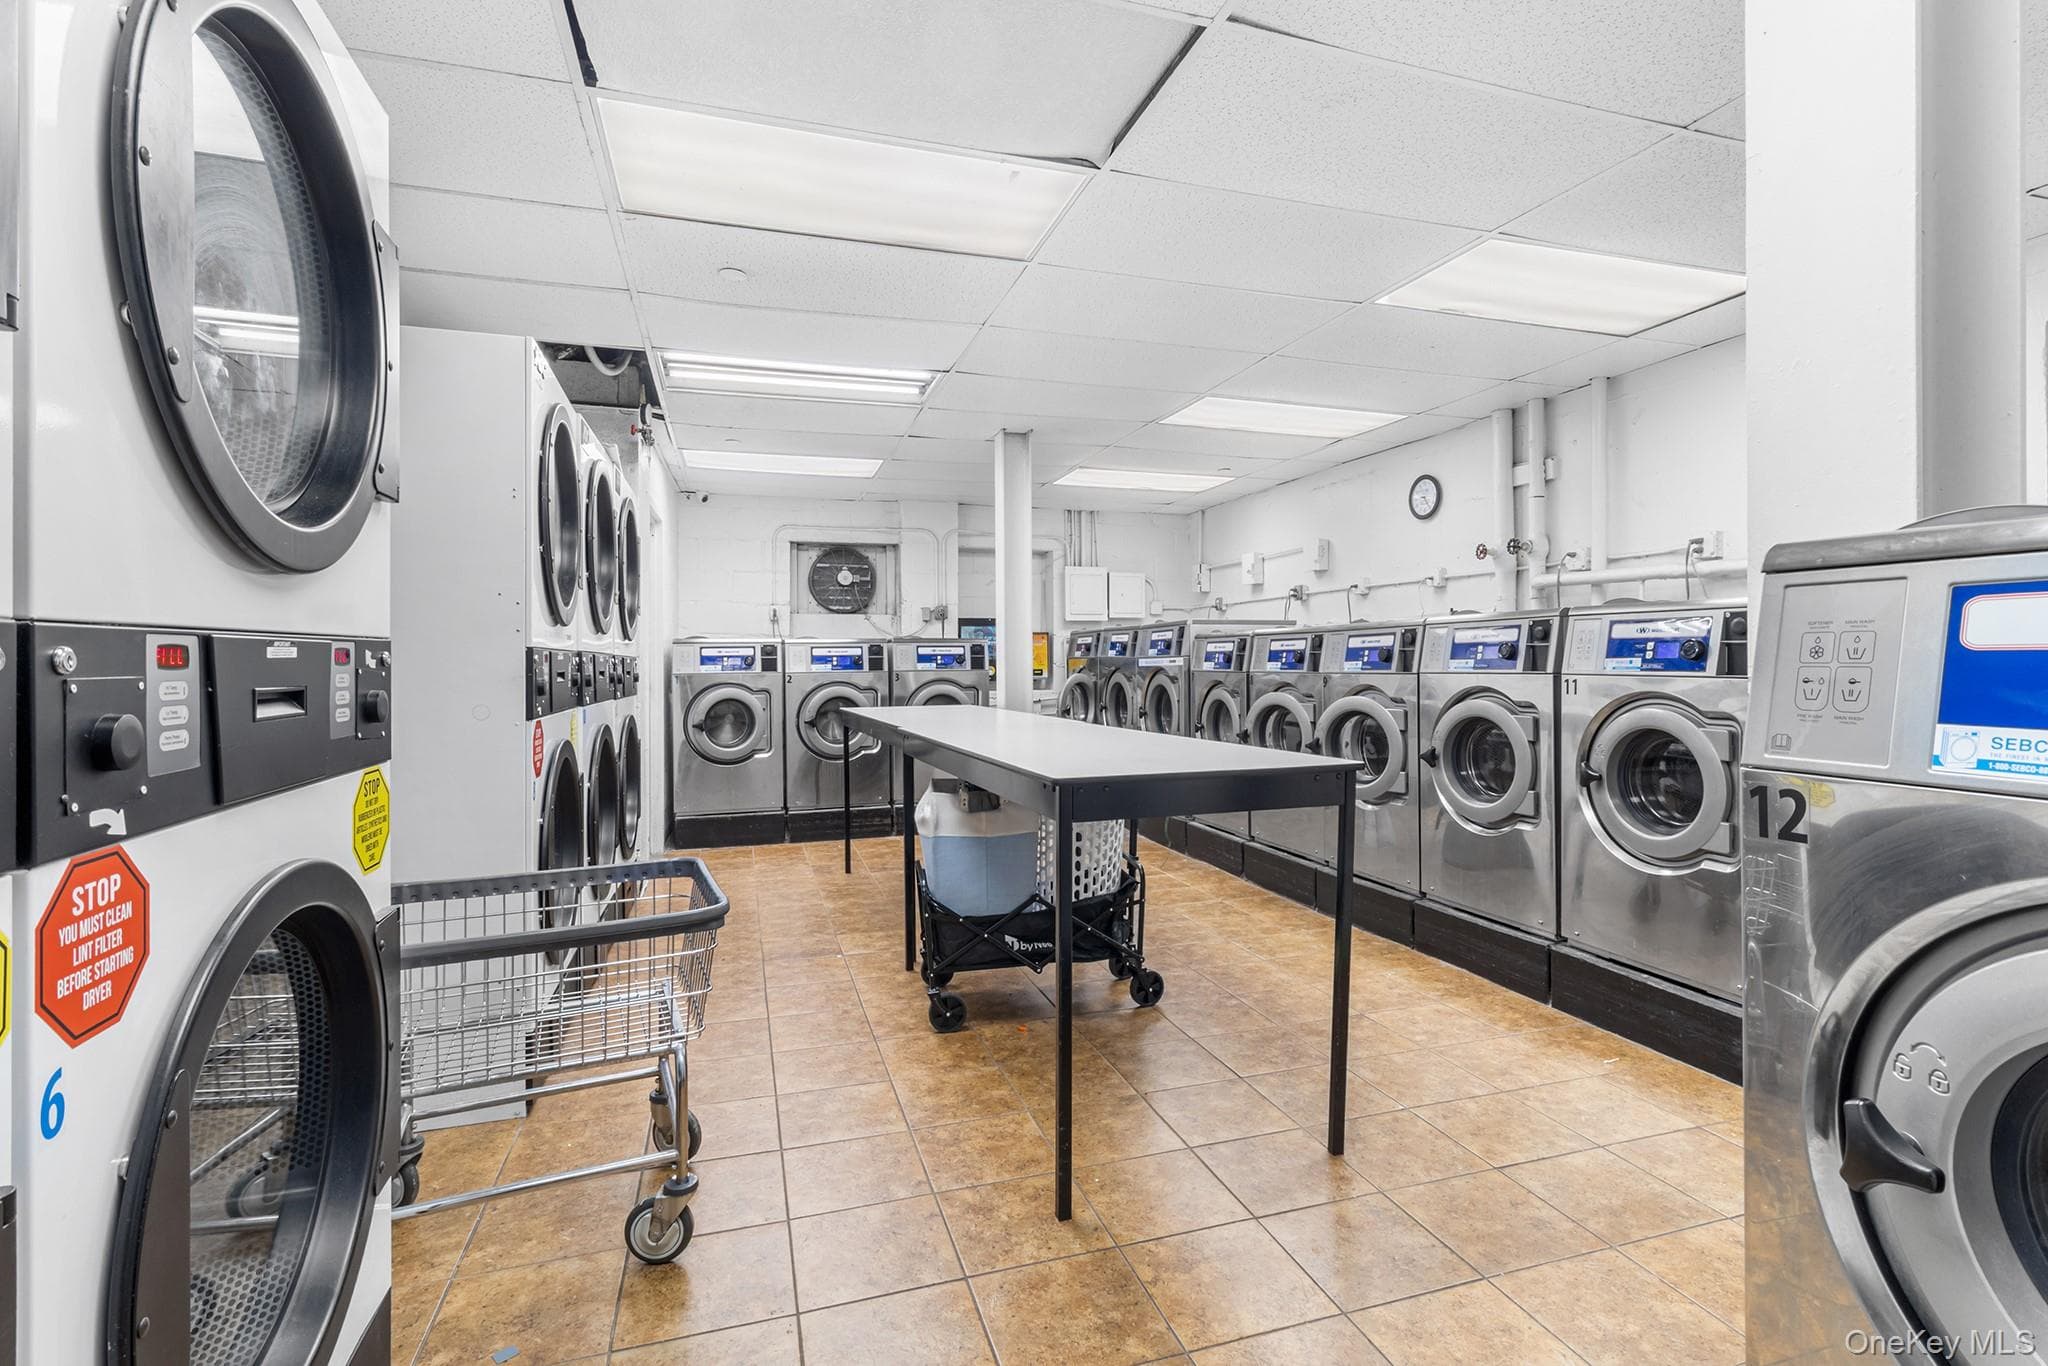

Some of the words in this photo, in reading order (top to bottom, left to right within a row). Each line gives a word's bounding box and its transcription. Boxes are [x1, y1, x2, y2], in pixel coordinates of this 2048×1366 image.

[786, 675, 792, 684] 2
[1564, 679, 1578, 695] 11
[363, 778, 380, 797] STOP
[1750, 785, 1808, 844] 12
[72, 873, 121, 916] STOP
[59, 923, 78, 947] YOU
[80, 912, 105, 939] MUST
[105, 900, 133, 928] CLEAN
[73, 941, 94, 967] LINT
[95, 928, 123, 957] FILTER
[57, 965, 93, 1000] BEFORE
[94, 946, 134, 981] STARTING
[82, 980, 112, 1011] DRYER
[41, 1066, 65, 1140] 6
